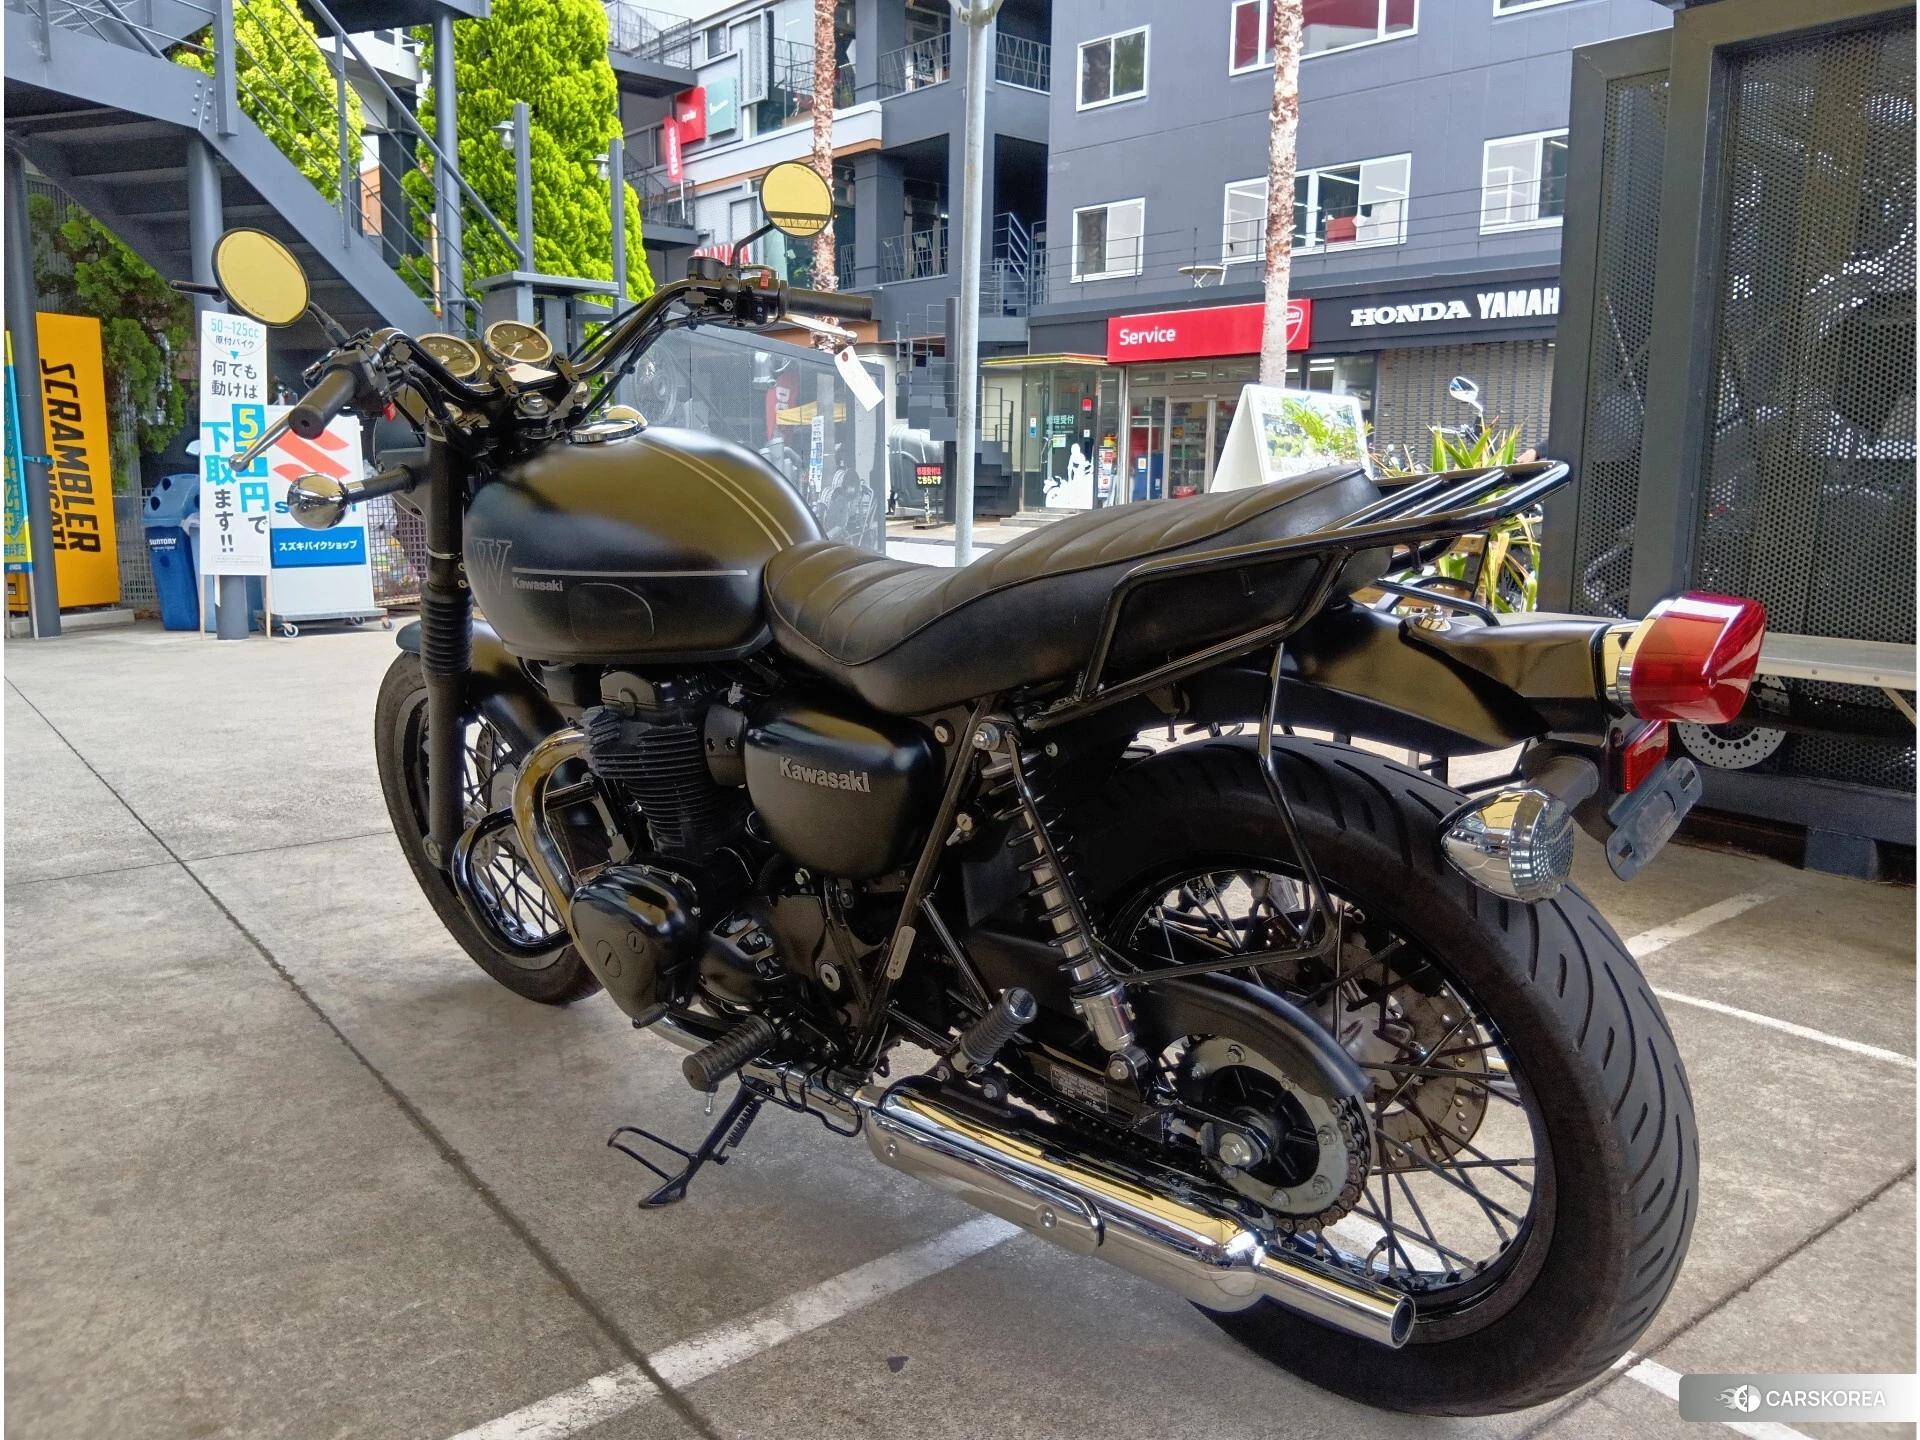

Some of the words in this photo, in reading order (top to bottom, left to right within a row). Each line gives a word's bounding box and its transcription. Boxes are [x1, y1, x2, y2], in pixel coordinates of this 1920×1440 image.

[1351, 301, 1471, 327] HONDA
[215, 335, 255, 349] 原付バイク
[1119, 326, 1176, 346] Service
[213, 360, 257, 379] 何でも
[211, 380, 258, 399] 動けば
[41, 358, 101, 552] SCRAMBLER
[917, 475, 943, 485] こちらです
[279, 540, 358, 552] スズキバイクショップ
[470, 537, 513, 595] W
[512, 576, 564, 592] Kawasaki
[780, 756, 871, 793] Kawasaki
